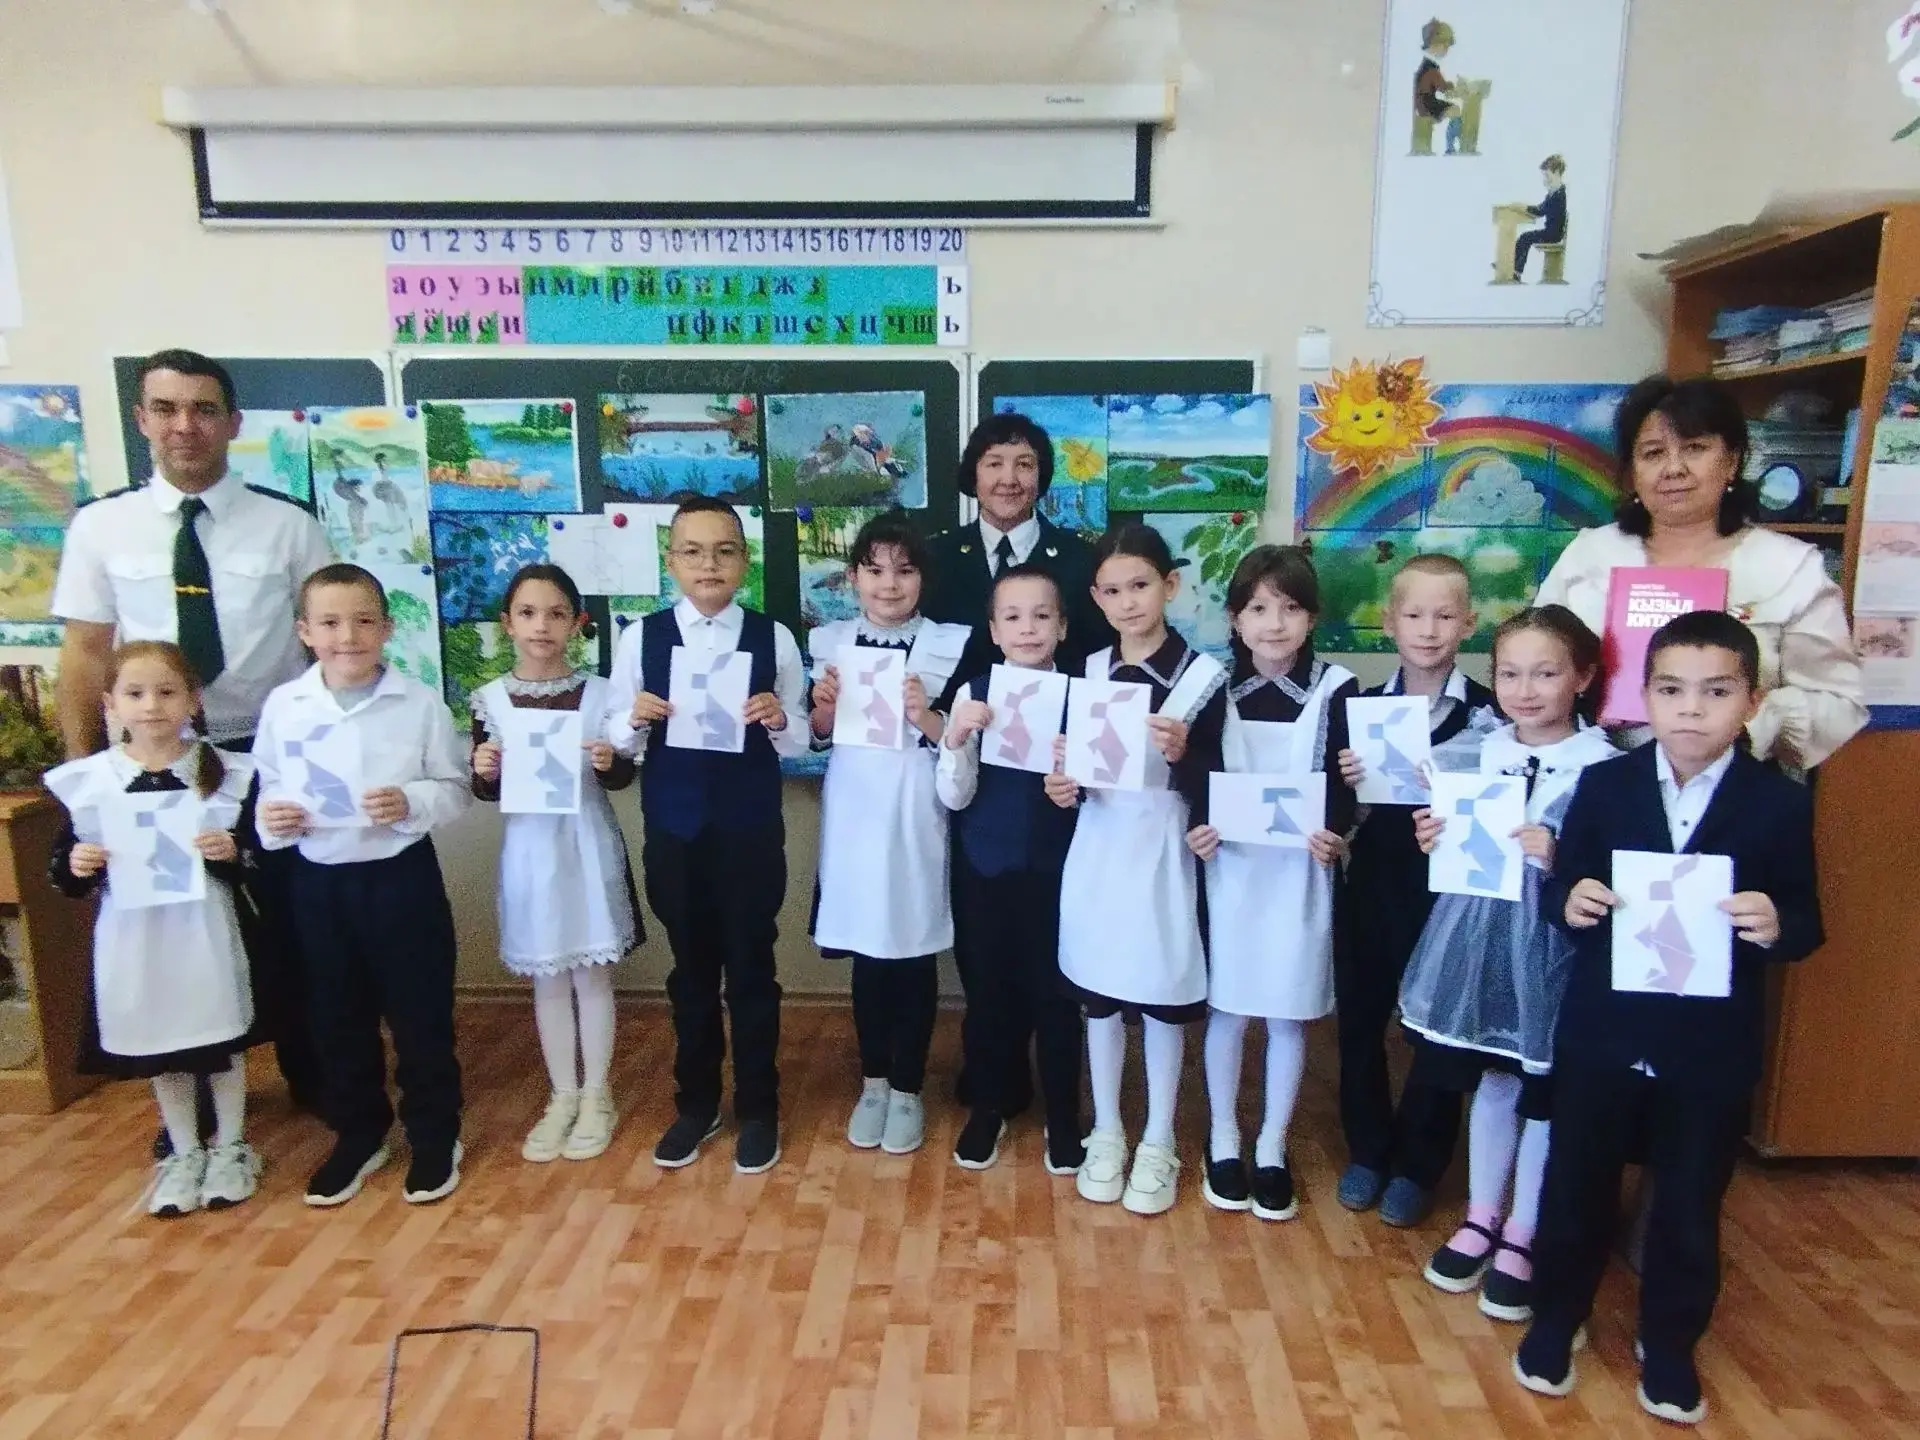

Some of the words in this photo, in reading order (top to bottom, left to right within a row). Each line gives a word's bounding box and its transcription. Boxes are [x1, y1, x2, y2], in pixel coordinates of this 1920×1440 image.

[392, 228, 405, 251] 0
[420, 228, 431, 251] 1
[448, 228, 460, 251] 2
[474, 228, 487, 251] 3
[501, 228, 515, 251] 4
[529, 228, 542, 251] 5
[556, 228, 569, 251] 6
[583, 228, 595, 251] 7
[611, 228, 623, 251] 8
[639, 228, 651, 251] 9
[662, 228, 682, 251] 10
[690, 228, 709, 251] 11
[716, 228, 738, 251] 12
[743, 228, 765, 251] 13
[773, 228, 794, 251] 14
[802, 228, 821, 251] 15
[827, 228, 849, 251] 16
[855, 228, 876, 251] 17
[883, 228, 904, 251] 18
[911, 228, 931, 251] 19
[939, 228, 962, 251] 20
[392, 276, 407, 295] а
[420, 277, 436, 296] о
[448, 276, 463, 301] у
[476, 276, 490, 296] э
[498, 276, 520, 295] ы
[529, 276, 547, 295] н
[553, 276, 575, 295] м
[578, 276, 599, 295] л
[611, 276, 629, 304] р
[636, 268, 654, 296] й
[666, 268, 682, 296] б
[750, 276, 768, 298] д
[774, 276, 795, 296] ж
[395, 314, 414, 334] я
[424, 308, 440, 334] ё
[447, 314, 470, 334] ю
[477, 314, 493, 334] е
[503, 315, 521, 334] и
[667, 314, 686, 334] п
[692, 307, 715, 342] ф
[723, 314, 740, 334] к
[774, 314, 798, 334] ш
[804, 314, 824, 334] с
[834, 314, 853, 334] х
[860, 314, 878, 337] ц
[887, 314, 905, 334] ч
[912, 314, 933, 337] щ
[1628, 598, 1694, 613] КЫЗЫЛ
[1626, 612, 1679, 627] КИТА
